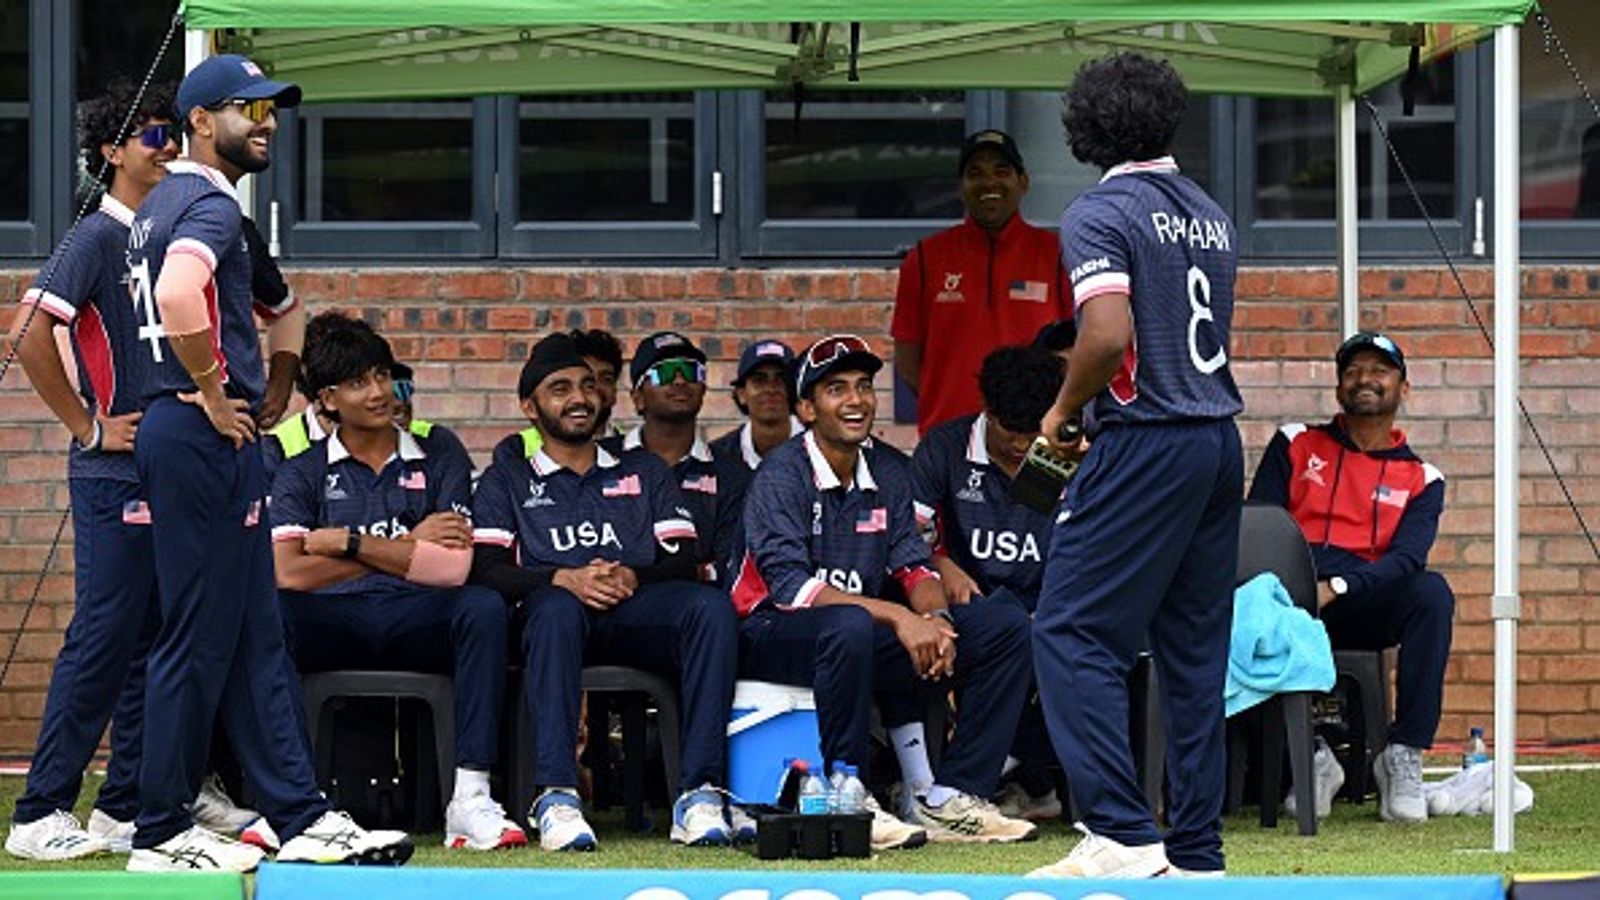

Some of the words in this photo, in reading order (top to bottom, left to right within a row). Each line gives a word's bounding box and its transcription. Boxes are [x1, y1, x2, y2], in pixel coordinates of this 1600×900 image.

[344, 517, 411, 540] SA
[549, 521, 623, 553] USA
[970, 527, 1041, 563] USA
